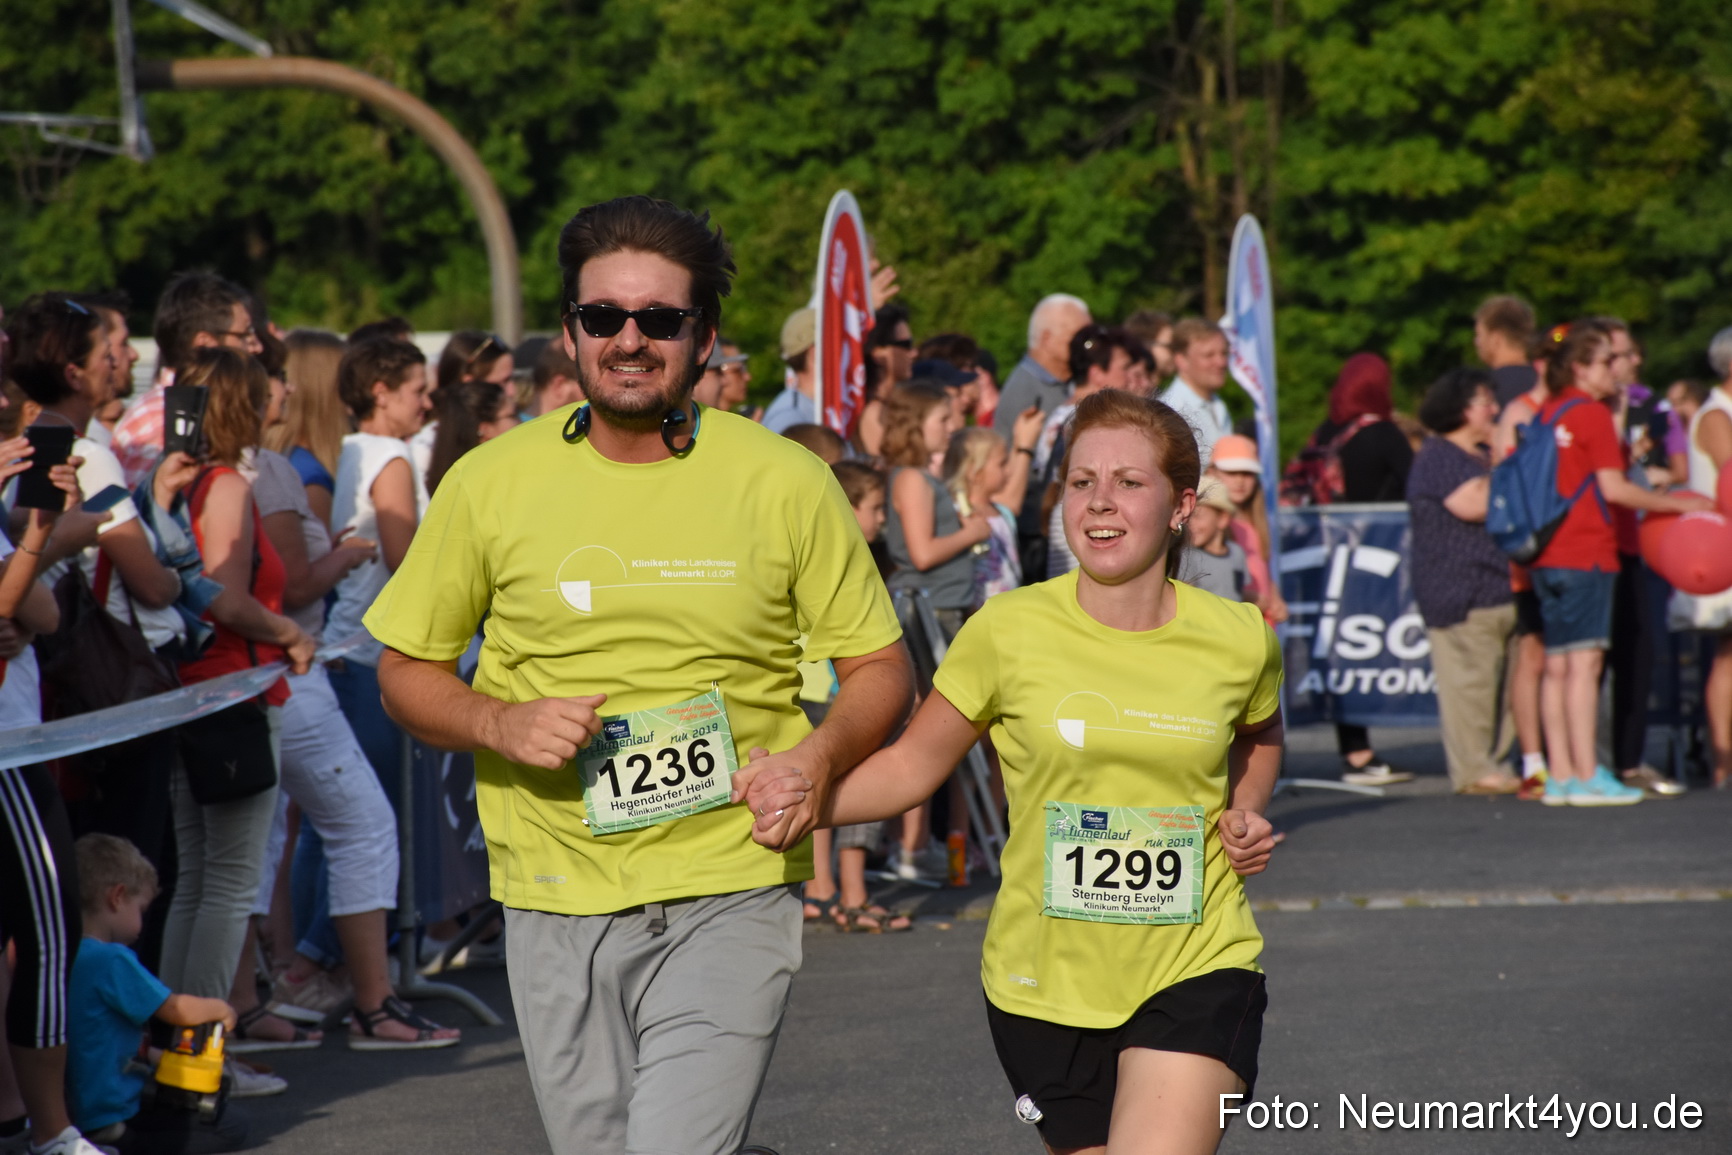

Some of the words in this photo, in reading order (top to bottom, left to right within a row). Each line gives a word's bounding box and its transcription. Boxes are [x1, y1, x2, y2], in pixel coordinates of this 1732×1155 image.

[631, 559, 669, 567] Kliniken
[672, 559, 687, 567] des
[689, 559, 737, 567] Landkreises
[660, 569, 705, 578] Neumarkt
[1296, 667, 1439, 695] AUTOM
[1123, 708, 1159, 719] Kliniken
[1161, 713, 1175, 721] des
[692, 722, 719, 739] 2019
[1149, 721, 1191, 733] Neumarkt
[597, 731, 655, 751] firmenlauf
[598, 738, 716, 798] 1236
[610, 788, 683, 811] Hegendörfer
[685, 777, 715, 794] Heidi
[627, 804, 663, 817] Klinikum
[664, 793, 702, 810] Neumarkt
[1069, 825, 1132, 841] firmenlauf
[1167, 837, 1194, 848] 2019
[1065, 845, 1182, 891] 1299
[1072, 888, 1131, 904] Sternberg
[1134, 893, 1174, 904] Evelyn
[1083, 902, 1120, 912] Klinikum
[1121, 904, 1161, 913] Neumarkt
